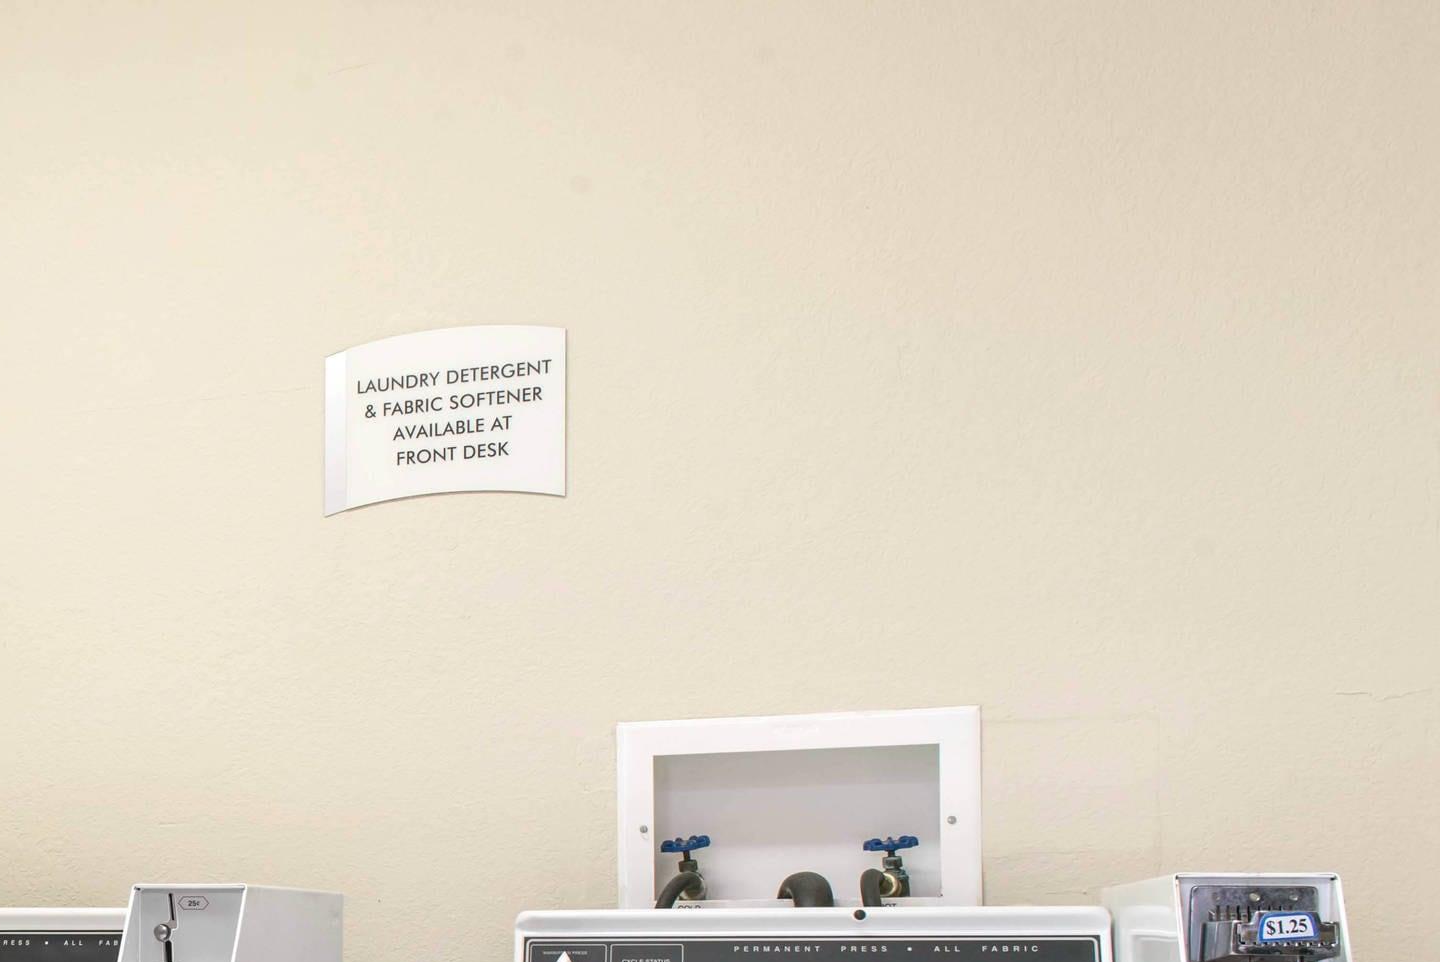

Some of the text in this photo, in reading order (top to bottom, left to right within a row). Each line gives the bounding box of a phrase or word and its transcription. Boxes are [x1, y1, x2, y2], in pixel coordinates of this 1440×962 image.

[357, 359, 552, 394] LAUNDRY DETERGENT
[364, 386, 543, 418] & FABRIC SOFTENER
[393, 415, 512, 441] AVAILABLE AT
[396, 441, 509, 466] FRONT DESK
[1266, 918, 1308, 936] $1.25
